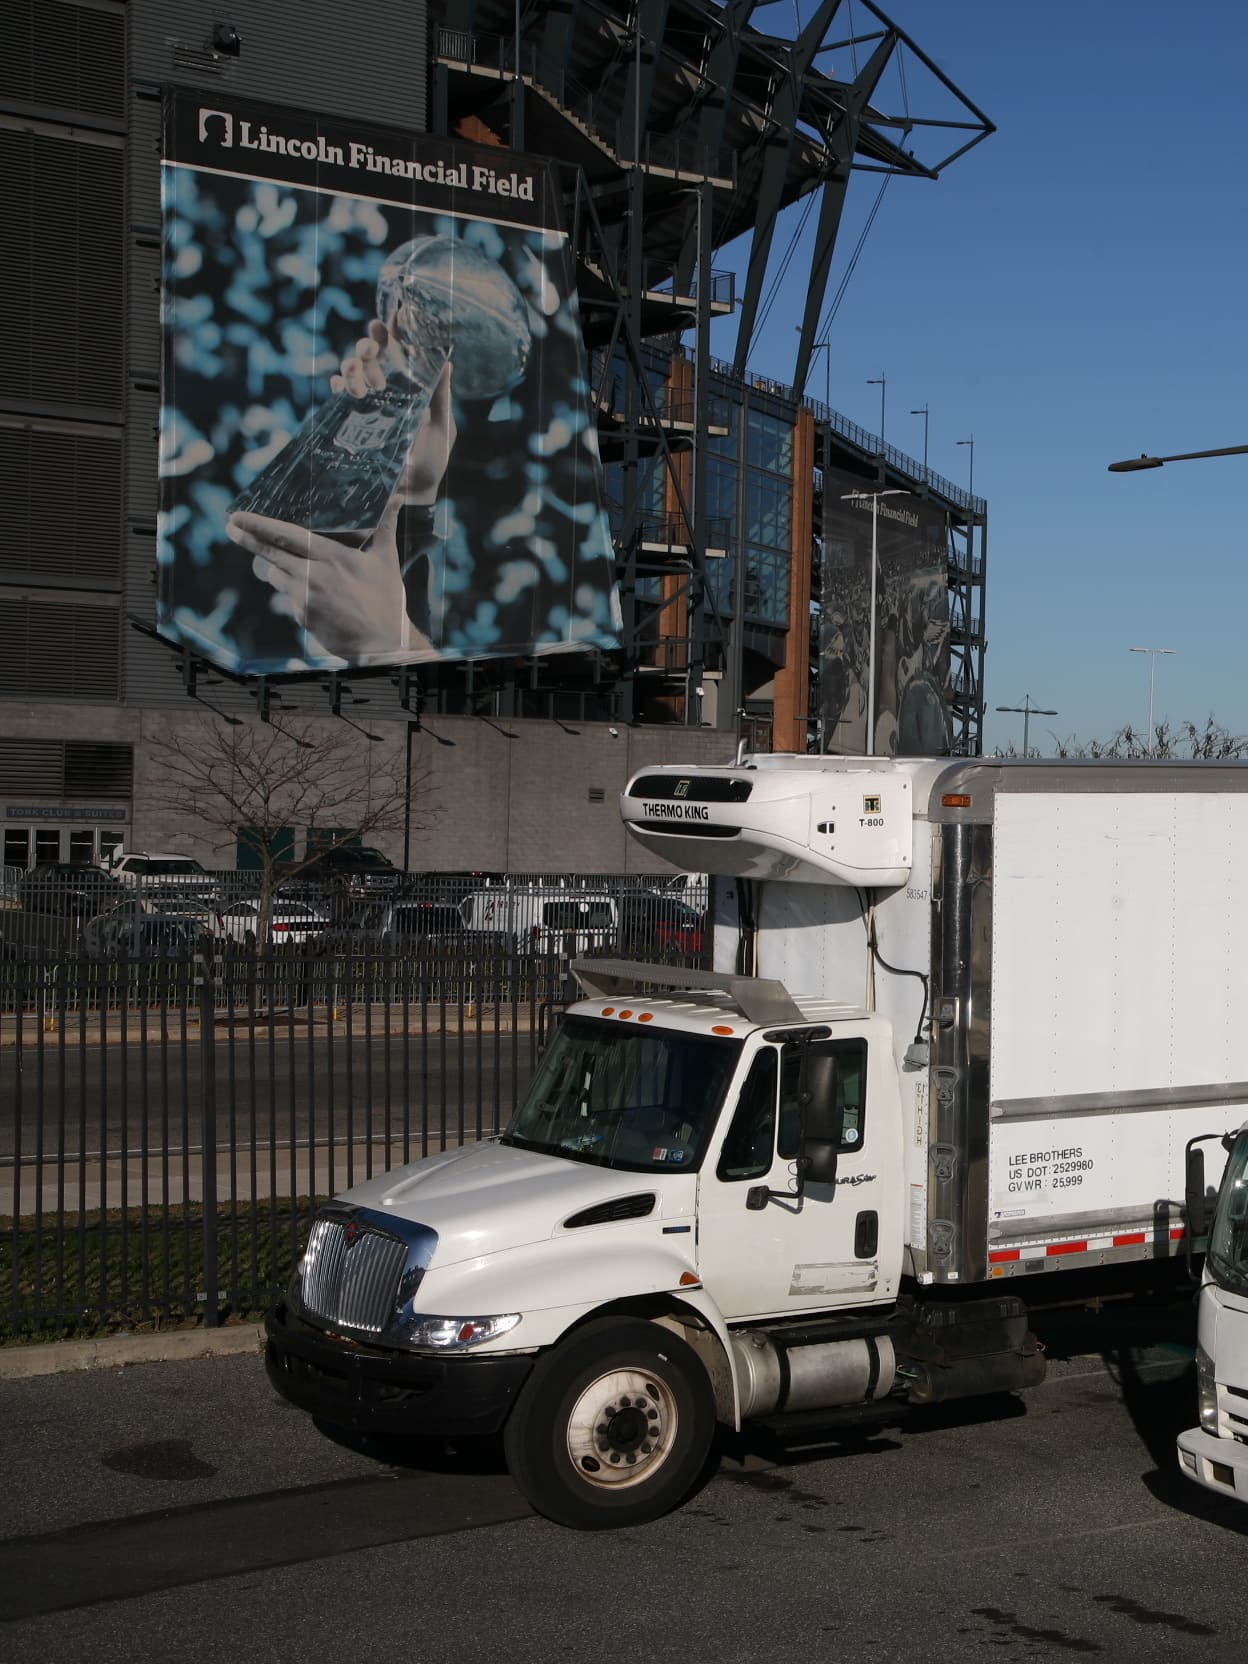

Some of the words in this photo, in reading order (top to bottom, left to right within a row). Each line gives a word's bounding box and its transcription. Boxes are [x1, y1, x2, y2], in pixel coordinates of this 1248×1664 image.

[240, 121, 344, 166] Lincoln
[349, 142, 468, 189] Financial
[472, 165, 534, 202] Field
[643, 802, 683, 818] THERMO
[684, 805, 709, 820] KING
[859, 818, 884, 828] T-800
[1009, 1154, 1028, 1166] LEE
[1029, 1147, 1083, 1163] BROTHERS
[1009, 1168, 1022, 1180] US
[1053, 1159, 1094, 1174] 2529980
